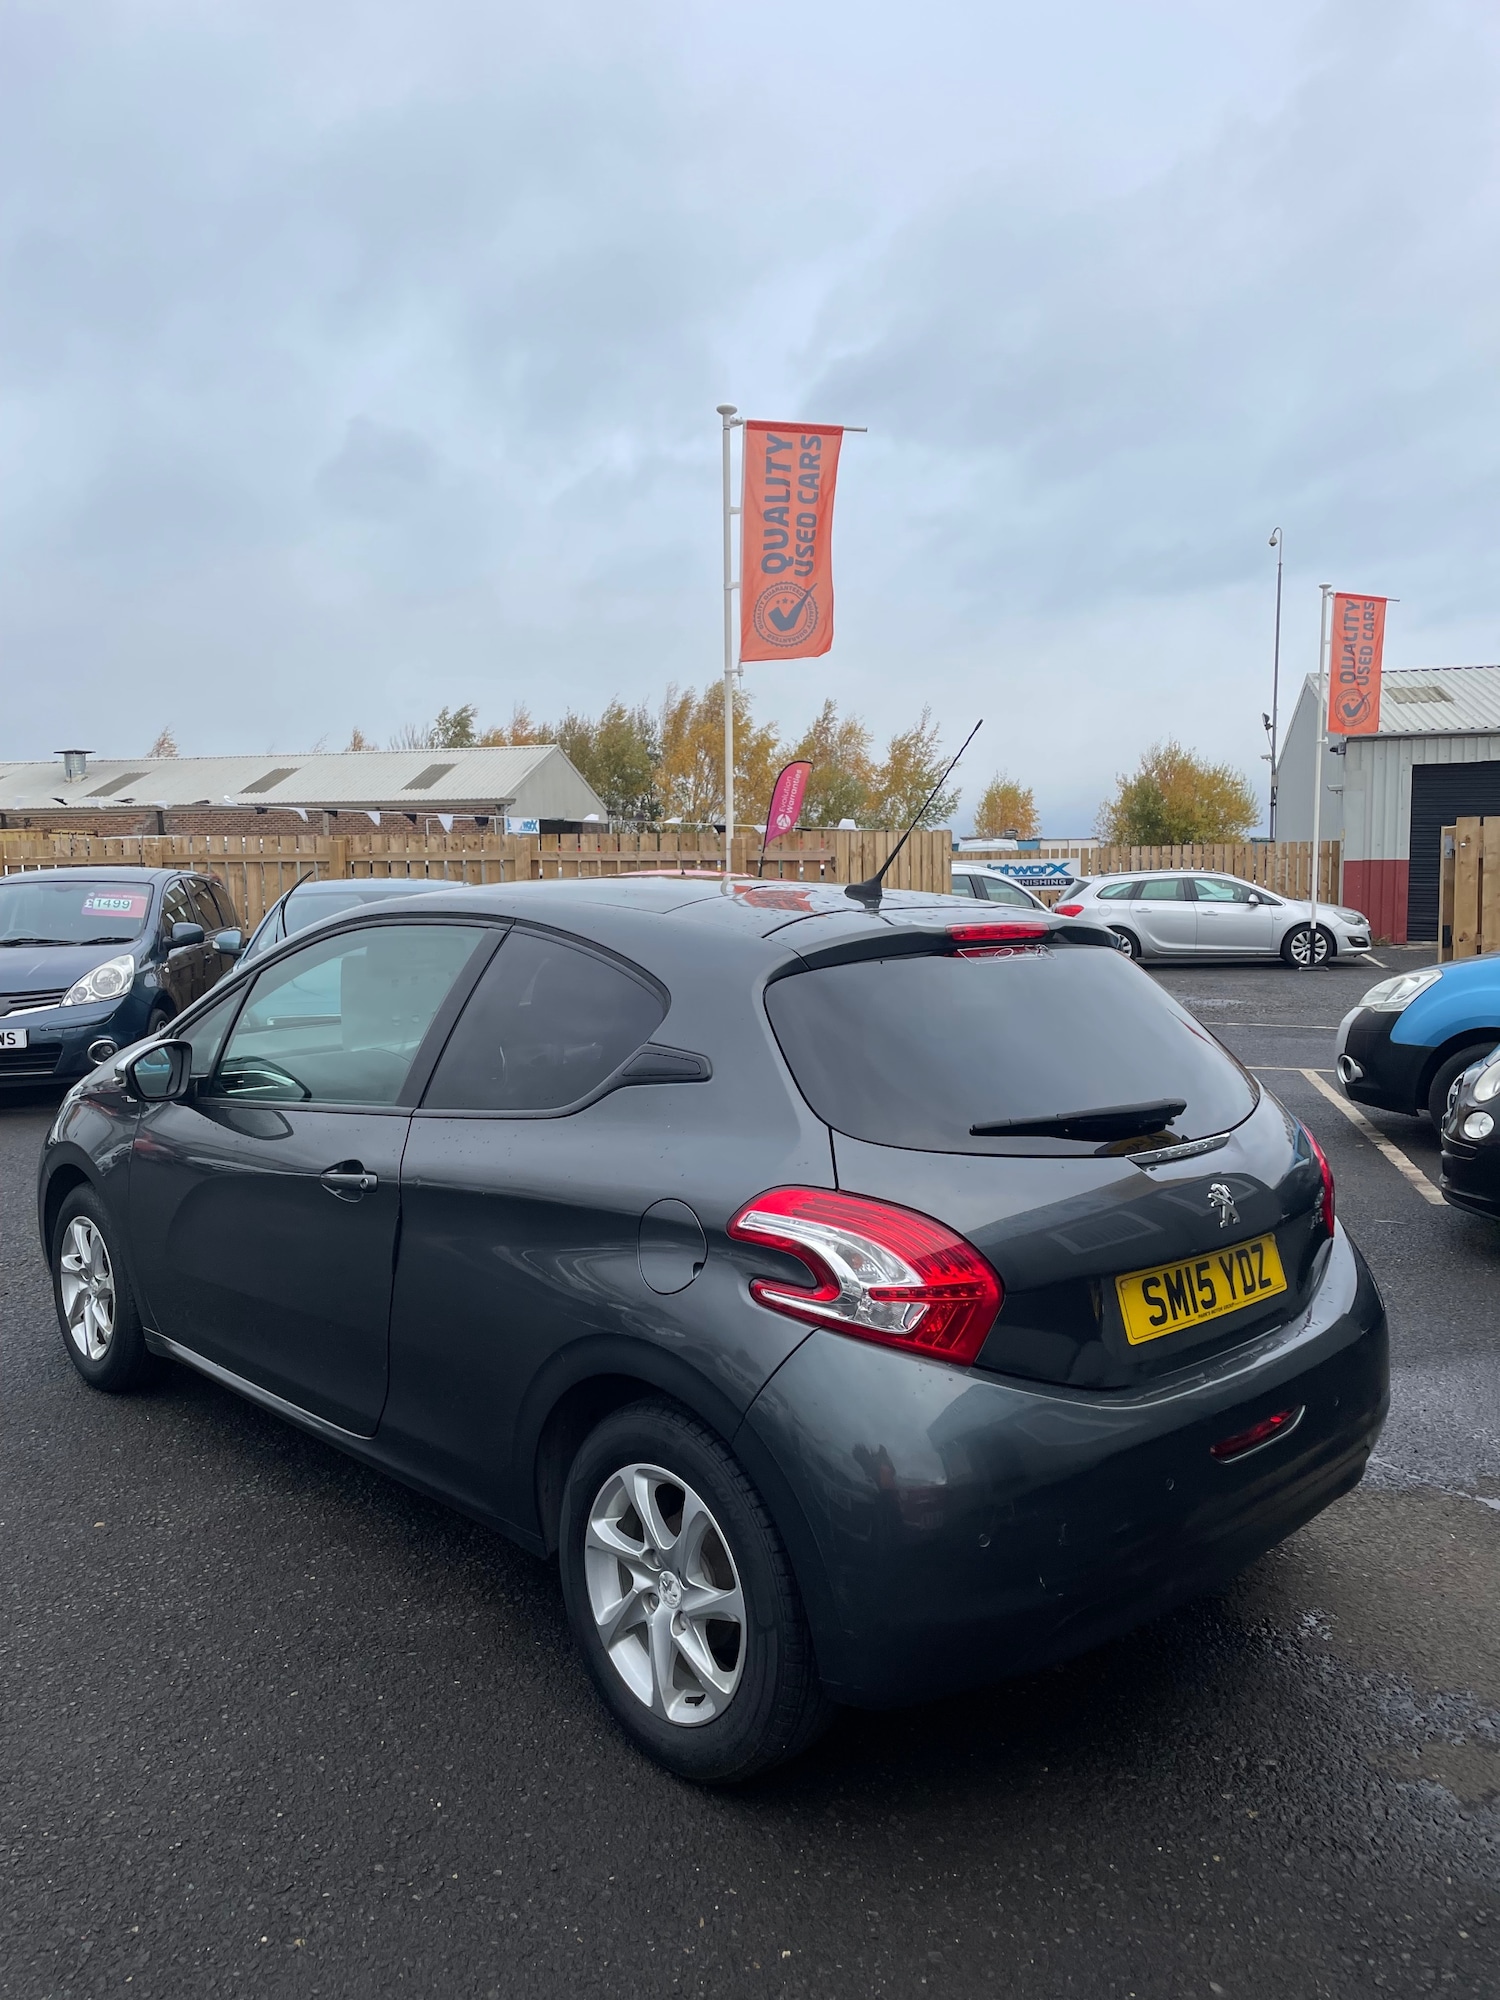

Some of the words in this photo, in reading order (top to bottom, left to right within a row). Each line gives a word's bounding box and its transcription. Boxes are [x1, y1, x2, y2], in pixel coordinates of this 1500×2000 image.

[761, 433, 794, 576] QUALITY
[797, 435, 822, 505] CARS
[794, 512, 817, 578] USED
[1340, 600, 1360, 684] QUALITY
[1363, 601, 1375, 641] CARS
[1356, 645, 1374, 686] USED
[1141, 1260, 1217, 1327] SM15
[1217, 1243, 1272, 1301] YDZ
